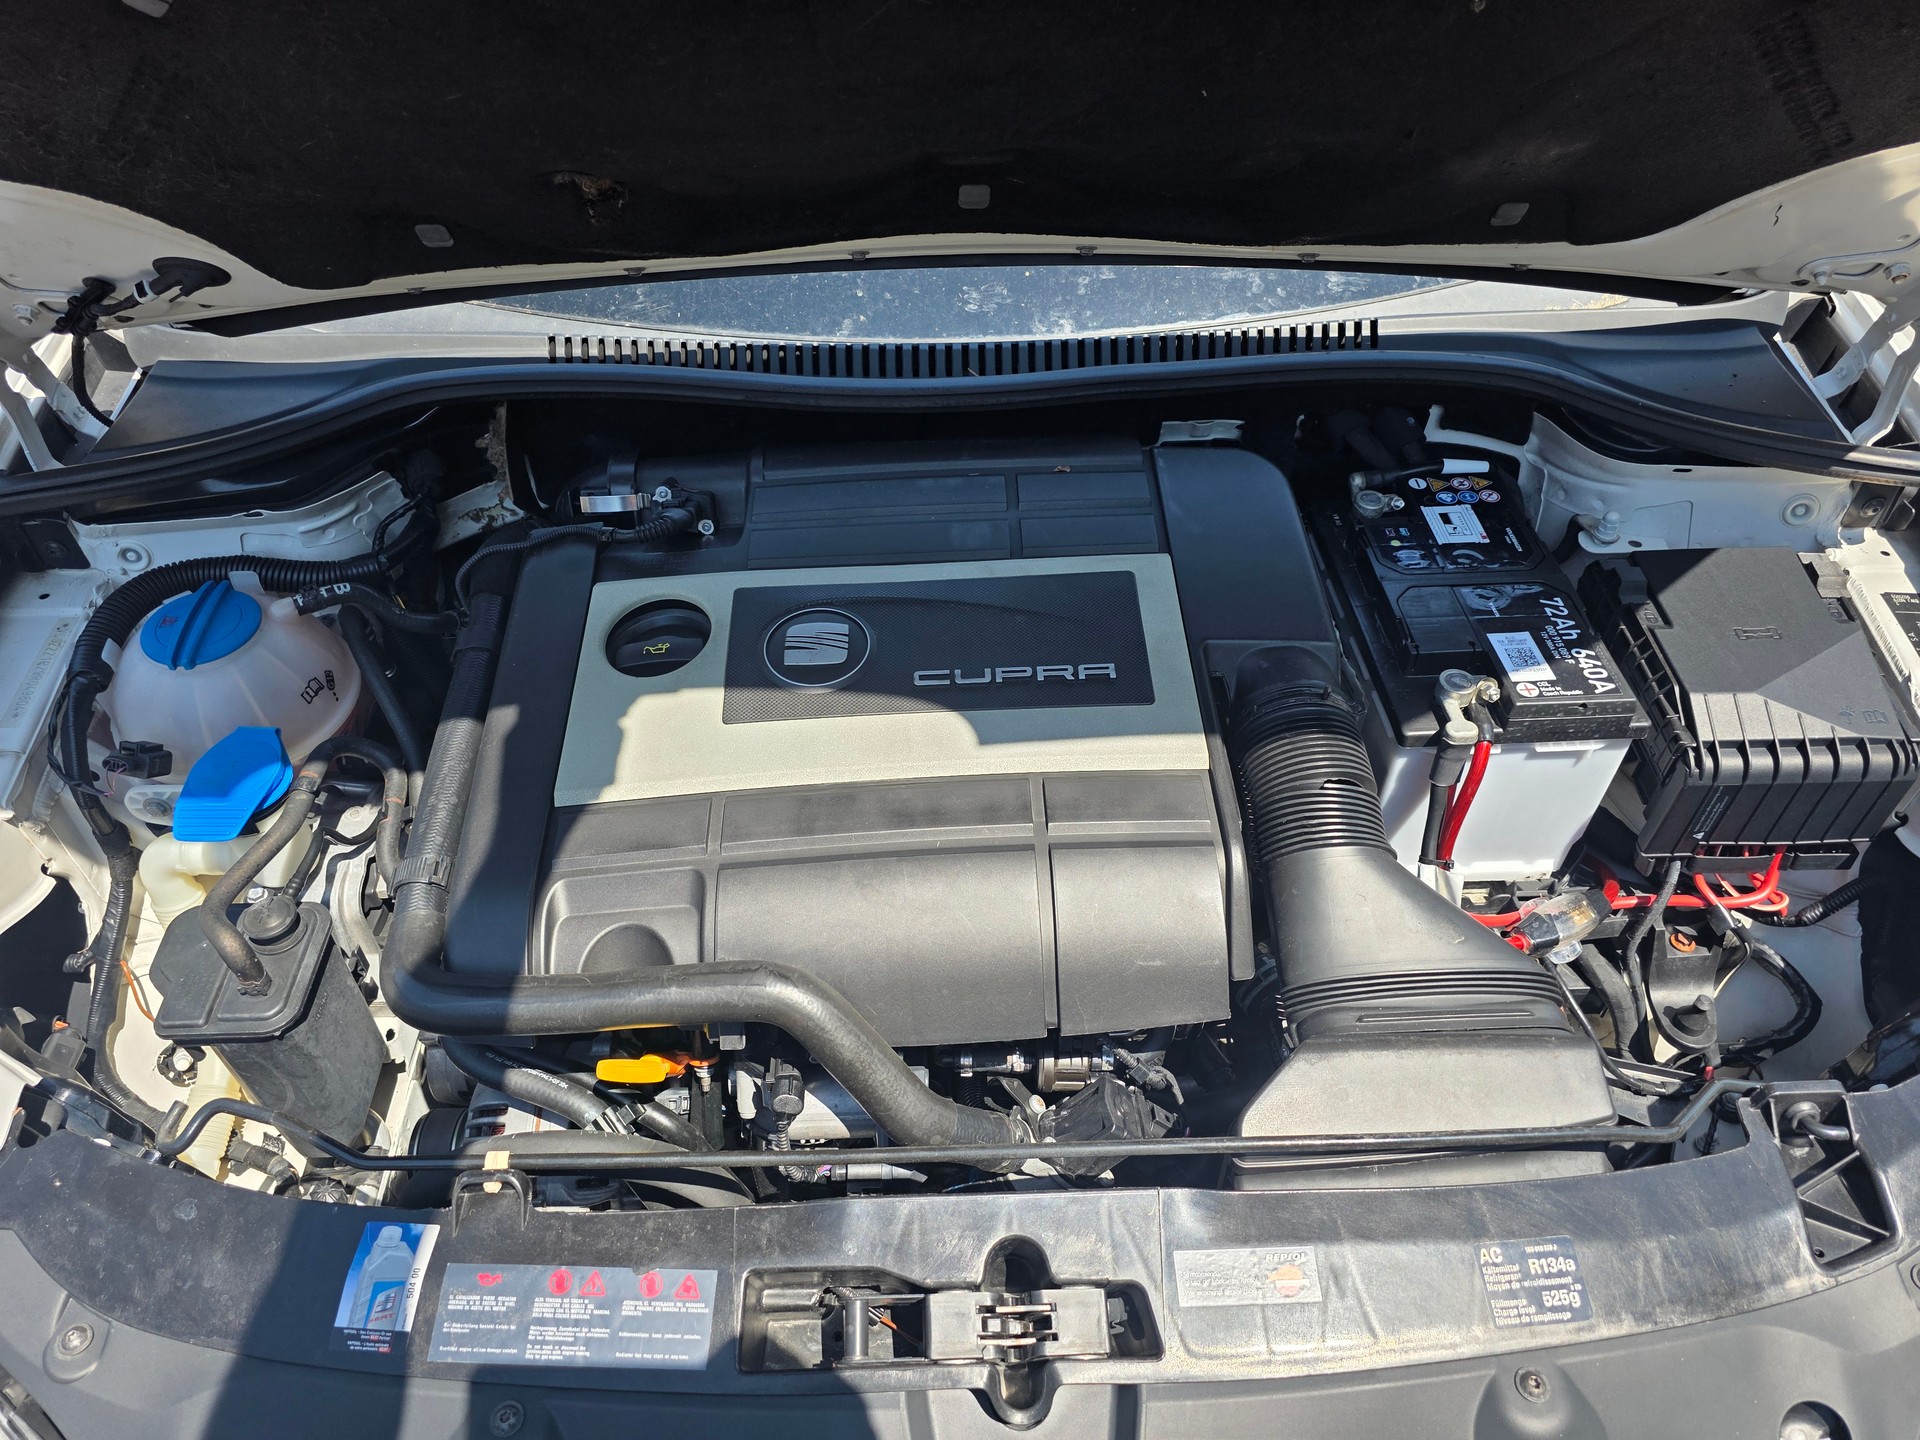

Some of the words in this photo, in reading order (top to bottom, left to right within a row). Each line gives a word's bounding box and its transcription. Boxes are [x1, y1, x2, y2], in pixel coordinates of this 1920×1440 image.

[1544, 625, 1558, 636] 000
[1551, 636, 1565, 648] 915
[1539, 597, 1581, 640] 72Ah
[1571, 648, 1616, 695] 640A
[912, 663, 1117, 687] CUPRA
[1265, 1252, 1306, 1261] REPSOL
[1480, 1247, 1503, 1265] AC
[411, 1267, 421, 1279] 00
[1528, 1256, 1576, 1275] R134a
[1484, 1273, 1521, 1283] Refrigerant
[1486, 1282, 1510, 1292] Moyen
[1511, 1281, 1521, 1289] de
[1521, 1276, 1573, 1287] refroidissement
[406, 1282, 417, 1299] 504
[1541, 1289, 1581, 1308] 525g
[1493, 1307, 1518, 1317] Charge
[1519, 1305, 1535, 1314] level
[1495, 1316, 1520, 1326] Niveau
[1521, 1314, 1530, 1323] de
[1531, 1311, 1572, 1323] remplissage
